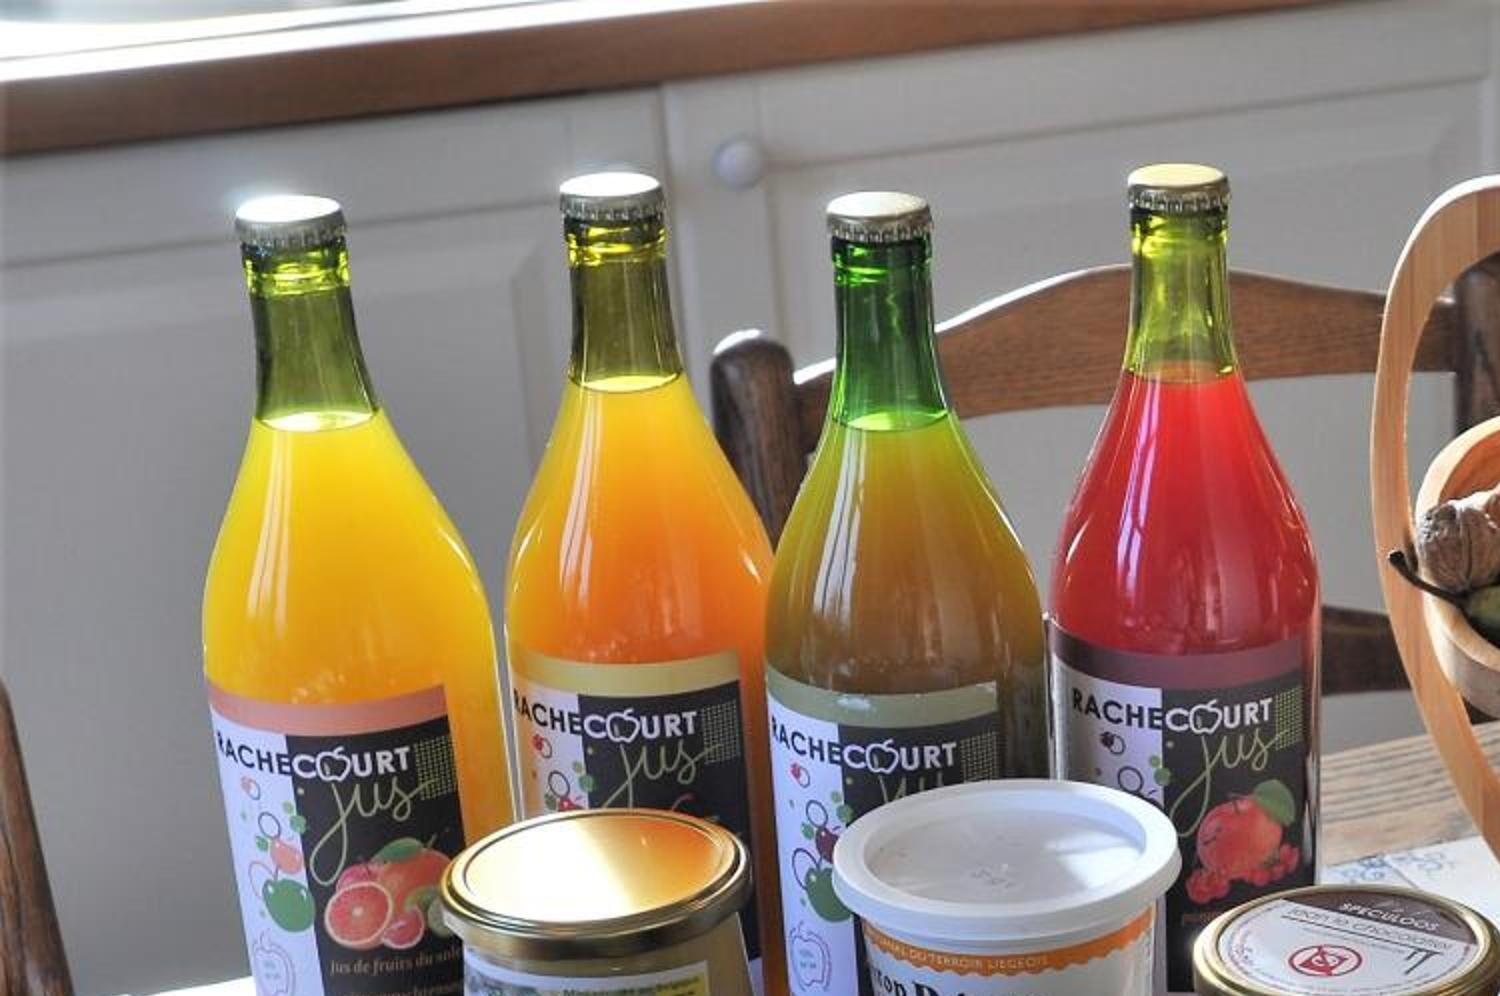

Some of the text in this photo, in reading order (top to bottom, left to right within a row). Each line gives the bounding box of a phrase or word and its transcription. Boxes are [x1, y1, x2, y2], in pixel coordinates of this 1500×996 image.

[513, 687, 698, 743] RACHECOURT
[1073, 687, 1273, 734] RACHECOURT
[217, 731, 410, 782] RACHECOURT
[771, 714, 957, 774] RACHECOURT
